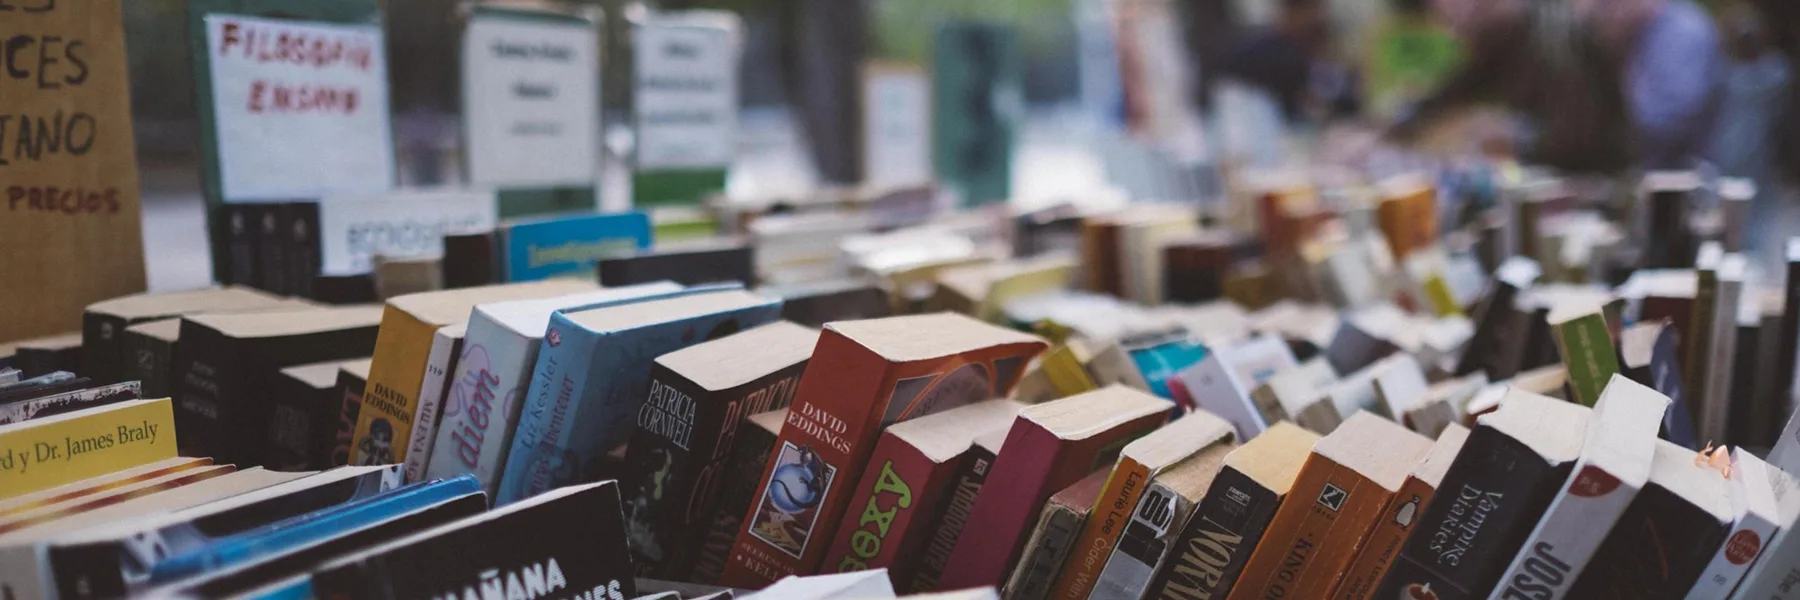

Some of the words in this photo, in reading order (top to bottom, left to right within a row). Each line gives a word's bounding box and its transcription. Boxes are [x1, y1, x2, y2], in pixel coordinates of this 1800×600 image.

[0, 34, 89, 90] CES
[6, 185, 121, 216] PRECIOS
[365, 389, 412, 425] EDDINGS
[374, 380, 408, 409] DAVID
[531, 355, 557, 423] Kessler
[647, 378, 697, 426] PATRICIA
[451, 366, 500, 470] diem
[637, 401, 693, 452] CORNWELL
[787, 410, 852, 455] EDDINGS
[801, 400, 848, 435] DAVID
[18, 451, 30, 473] y
[35, 442, 61, 463] Dr.
[65, 432, 115, 461] James
[117, 420, 159, 445] Braly
[1111, 470, 1143, 514] Laurie
[1099, 510, 1123, 537] Lee
[1428, 482, 1483, 555] Diaries
[1446, 489, 1504, 568] Vampire
[1084, 536, 1110, 573] Cider
[1279, 537, 1313, 582] KING
[1067, 572, 1091, 599] With
